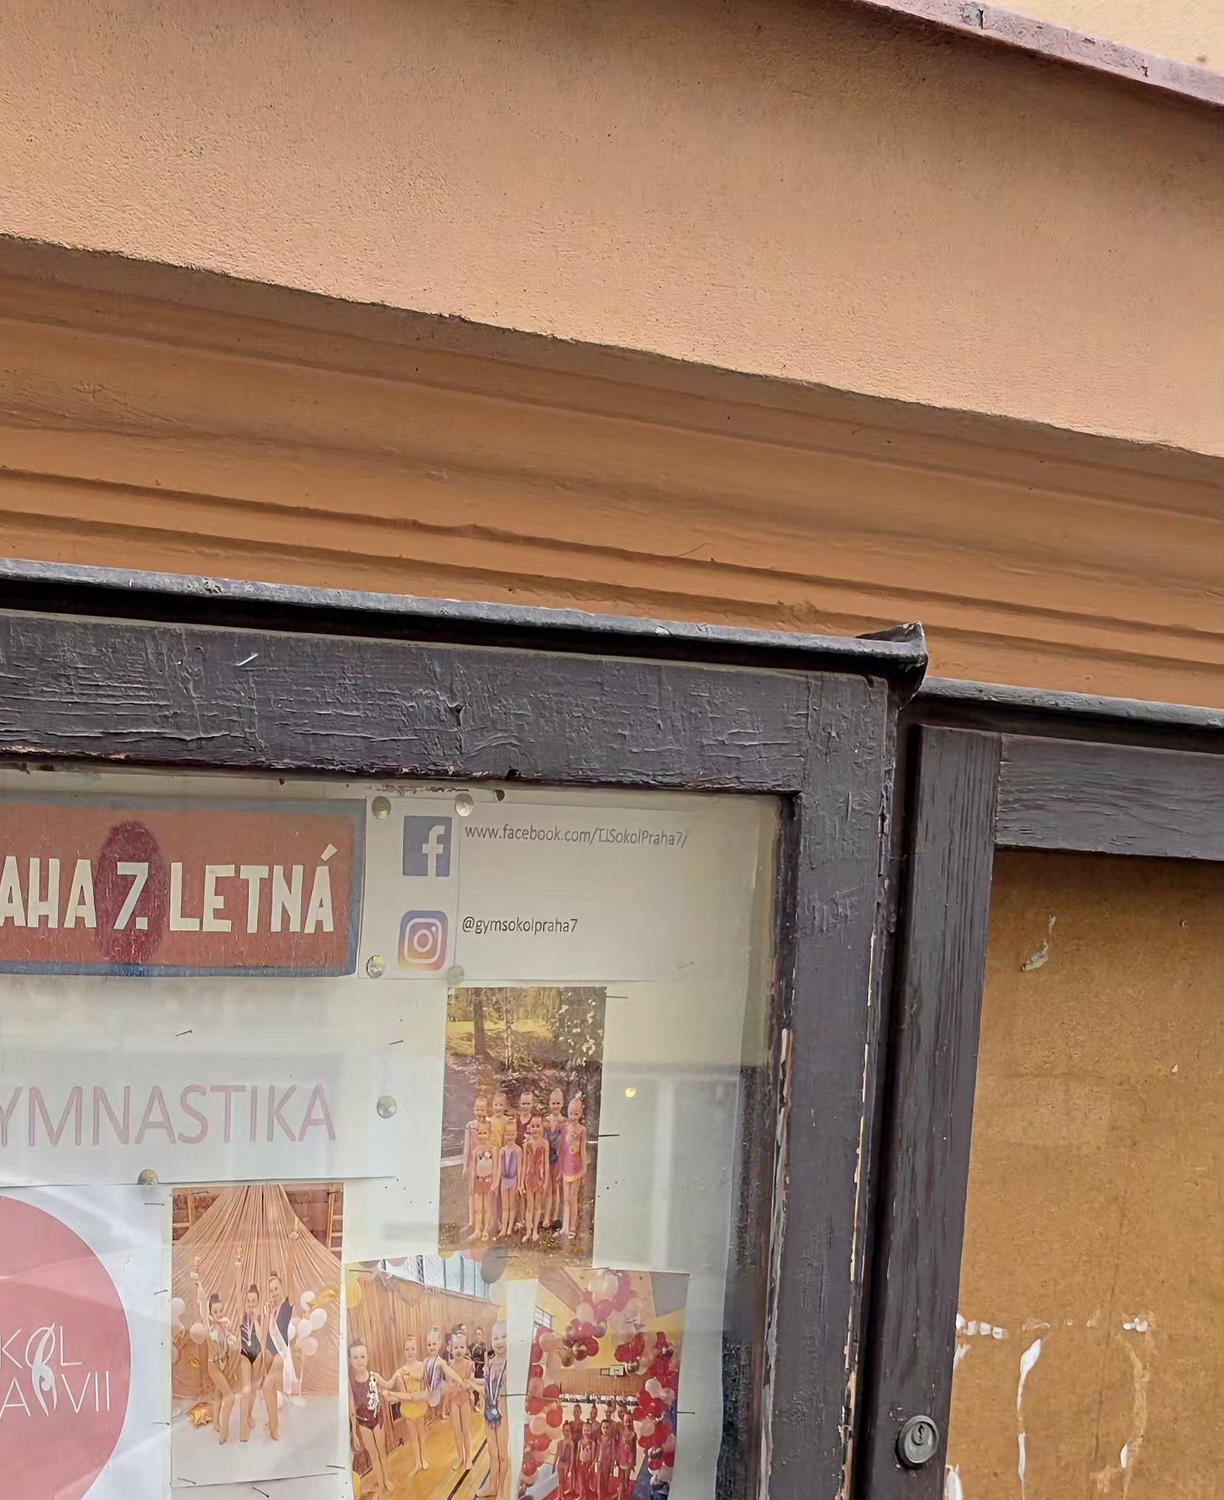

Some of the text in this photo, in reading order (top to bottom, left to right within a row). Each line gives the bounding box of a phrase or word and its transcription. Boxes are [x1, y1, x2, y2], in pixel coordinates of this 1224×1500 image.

[168, 843, 338, 933] LETNÁ
[462, 916, 578, 935] @gymsokolpraha7
[62, 1370, 111, 1415] VII
